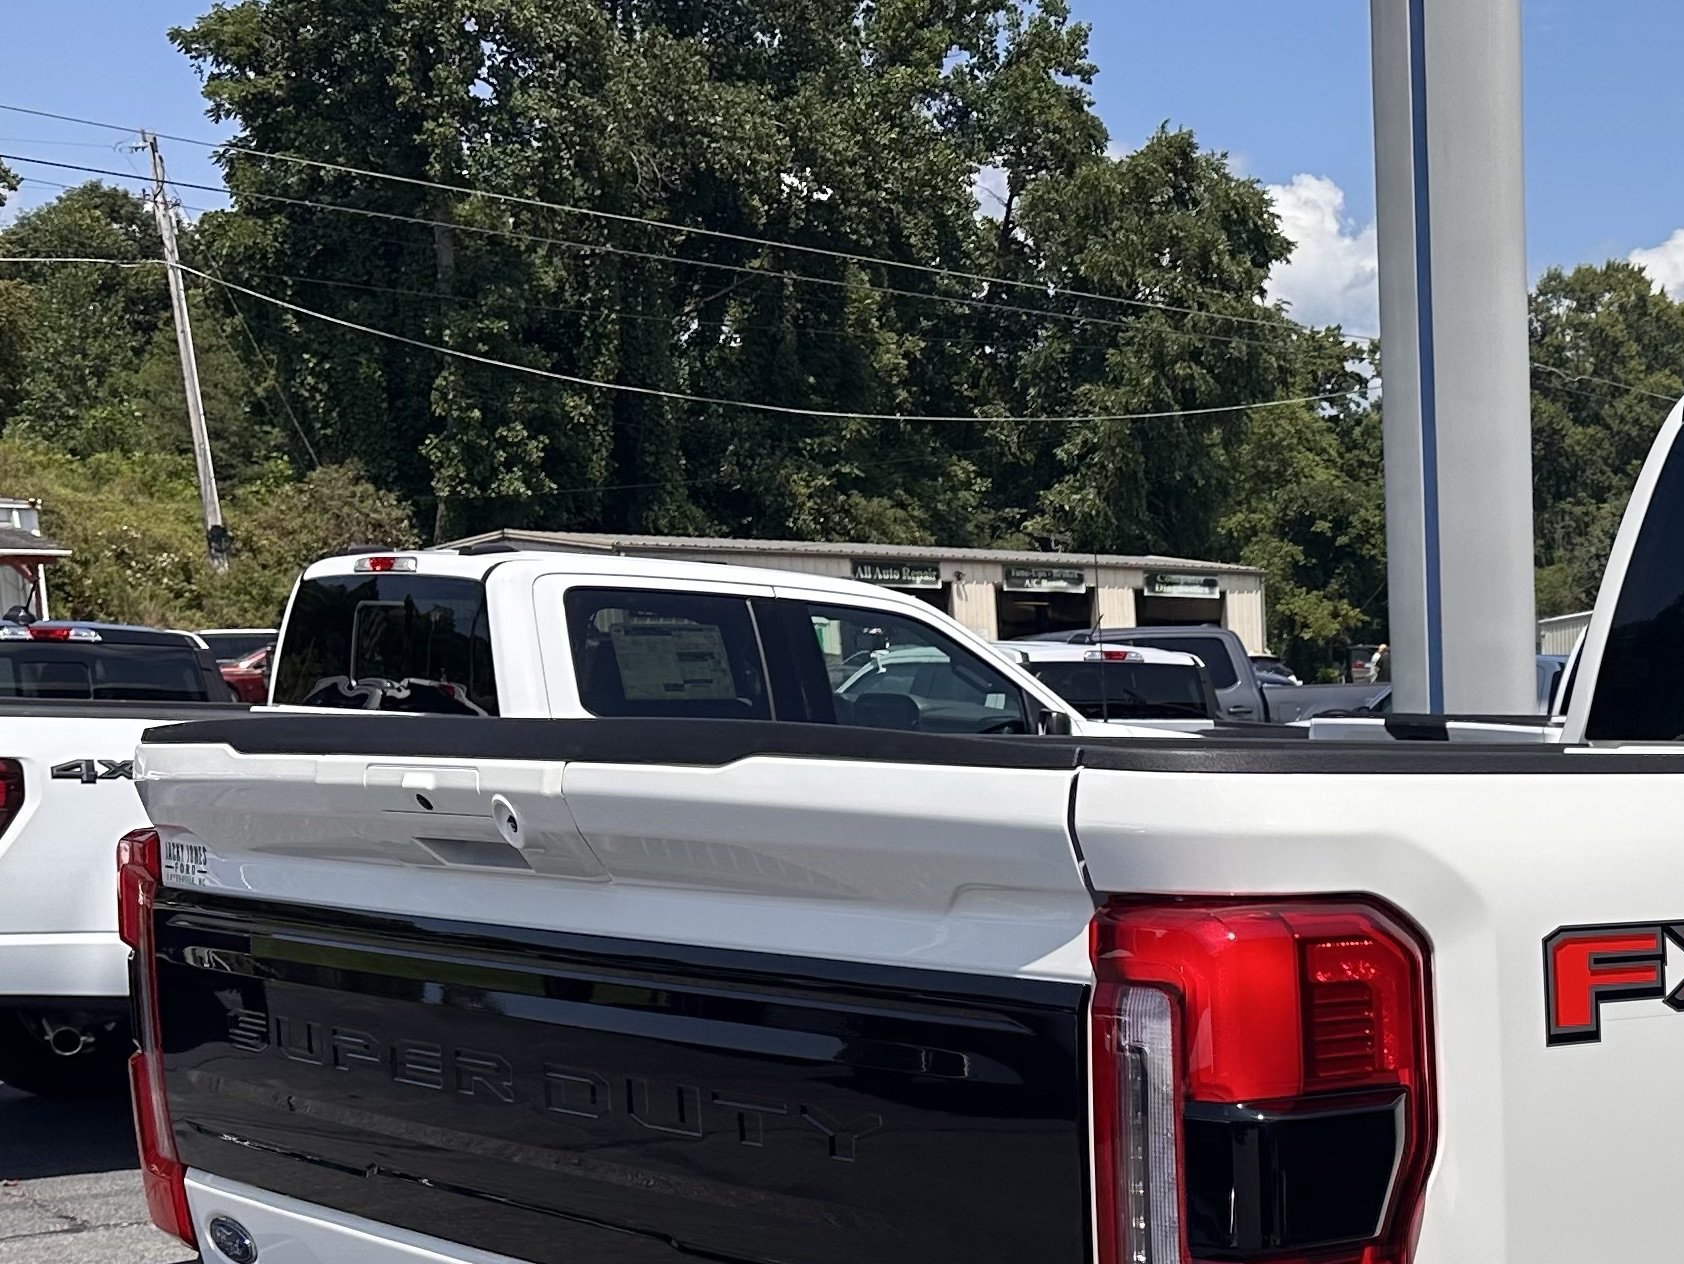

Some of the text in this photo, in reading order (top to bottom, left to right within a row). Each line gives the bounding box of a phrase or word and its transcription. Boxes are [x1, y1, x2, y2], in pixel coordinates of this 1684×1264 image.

[855, 565, 938, 584] All Auto Repair
[174, 861, 196, 876] FORD
[227, 1006, 884, 1164] SUPER DUTY
